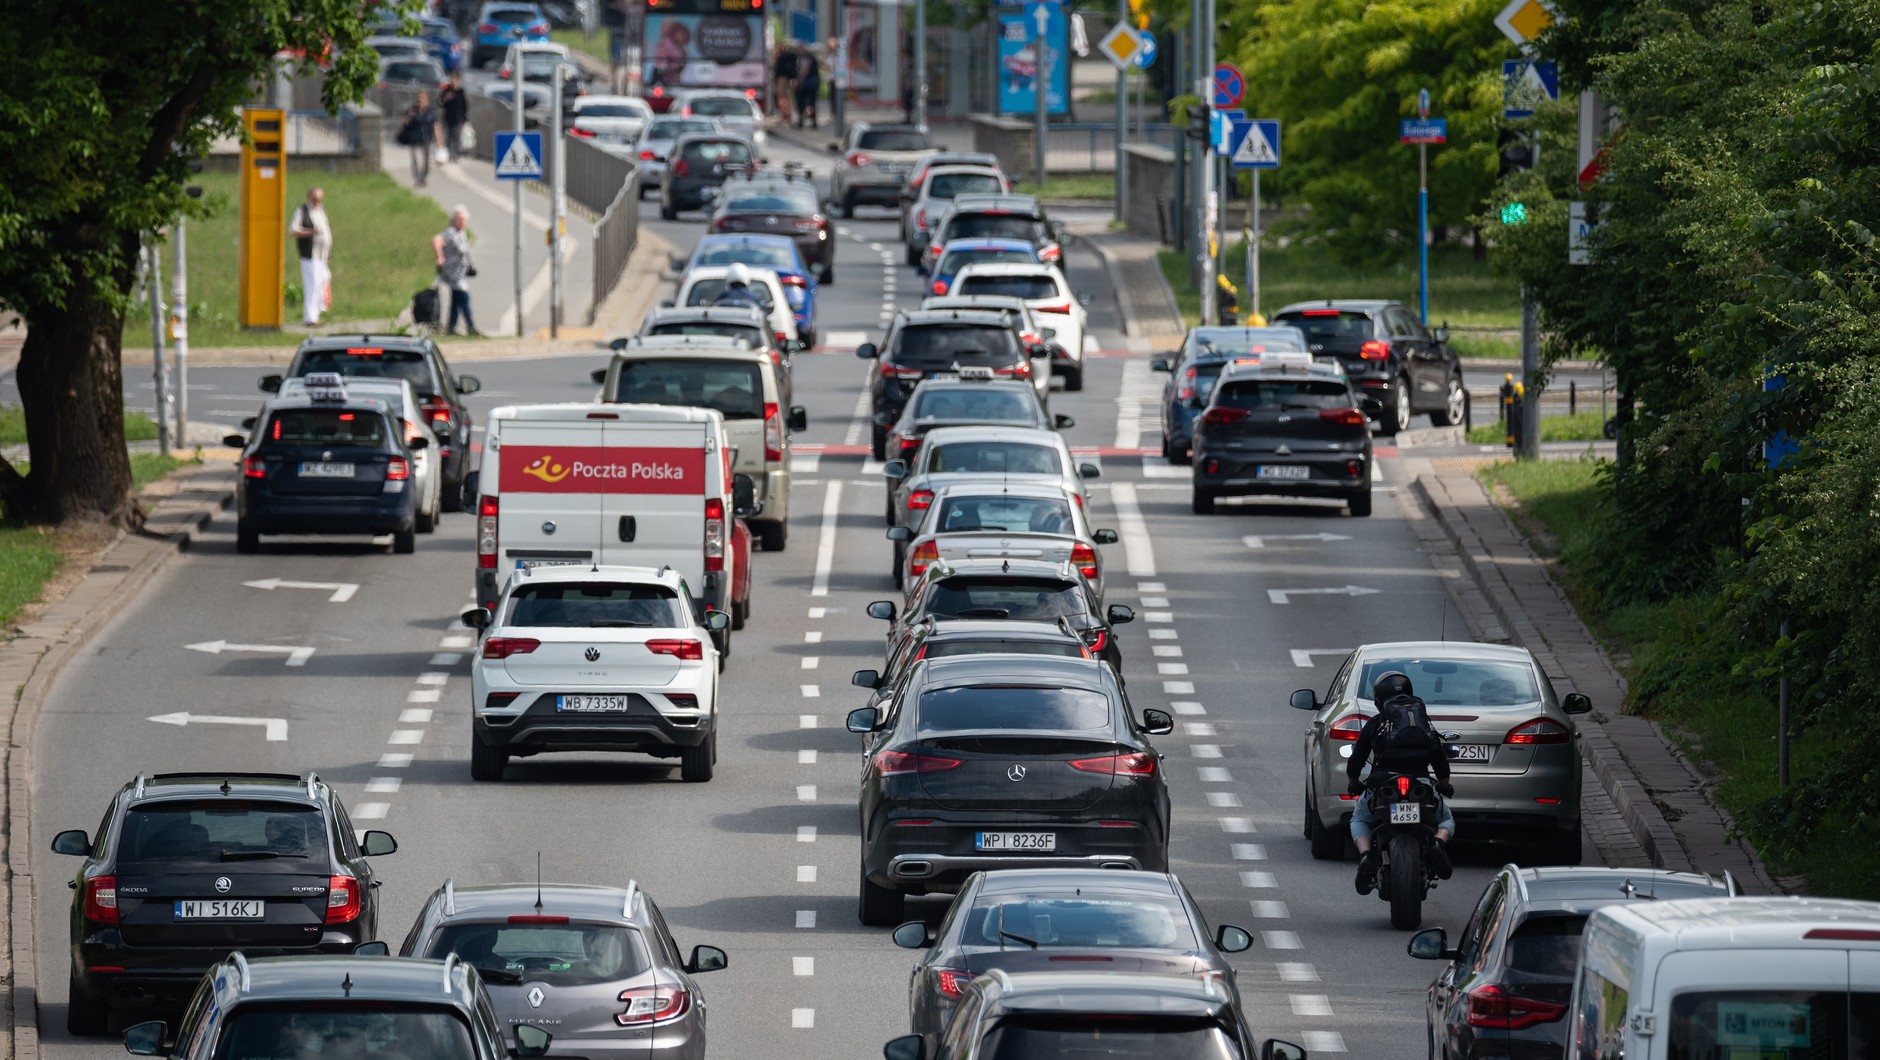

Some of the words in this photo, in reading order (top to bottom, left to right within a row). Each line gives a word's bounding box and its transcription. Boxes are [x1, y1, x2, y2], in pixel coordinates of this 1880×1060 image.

[310, 376, 337, 384] TAXI
[317, 391, 342, 400] TAXI
[573, 461, 627, 478] Poczta
[632, 462, 684, 480] Polska
[565, 697, 581, 709] WB
[586, 697, 625, 709] 7335W
[1399, 804, 1412, 812] WN
[1392, 813, 1418, 822] 4659
[983, 834, 1006, 847] WPI
[1013, 834, 1054, 848] 8236F
[185, 901, 202, 917] WI
[212, 901, 259, 917] 516KJ
[1751, 1018, 1785, 1029] MTON
